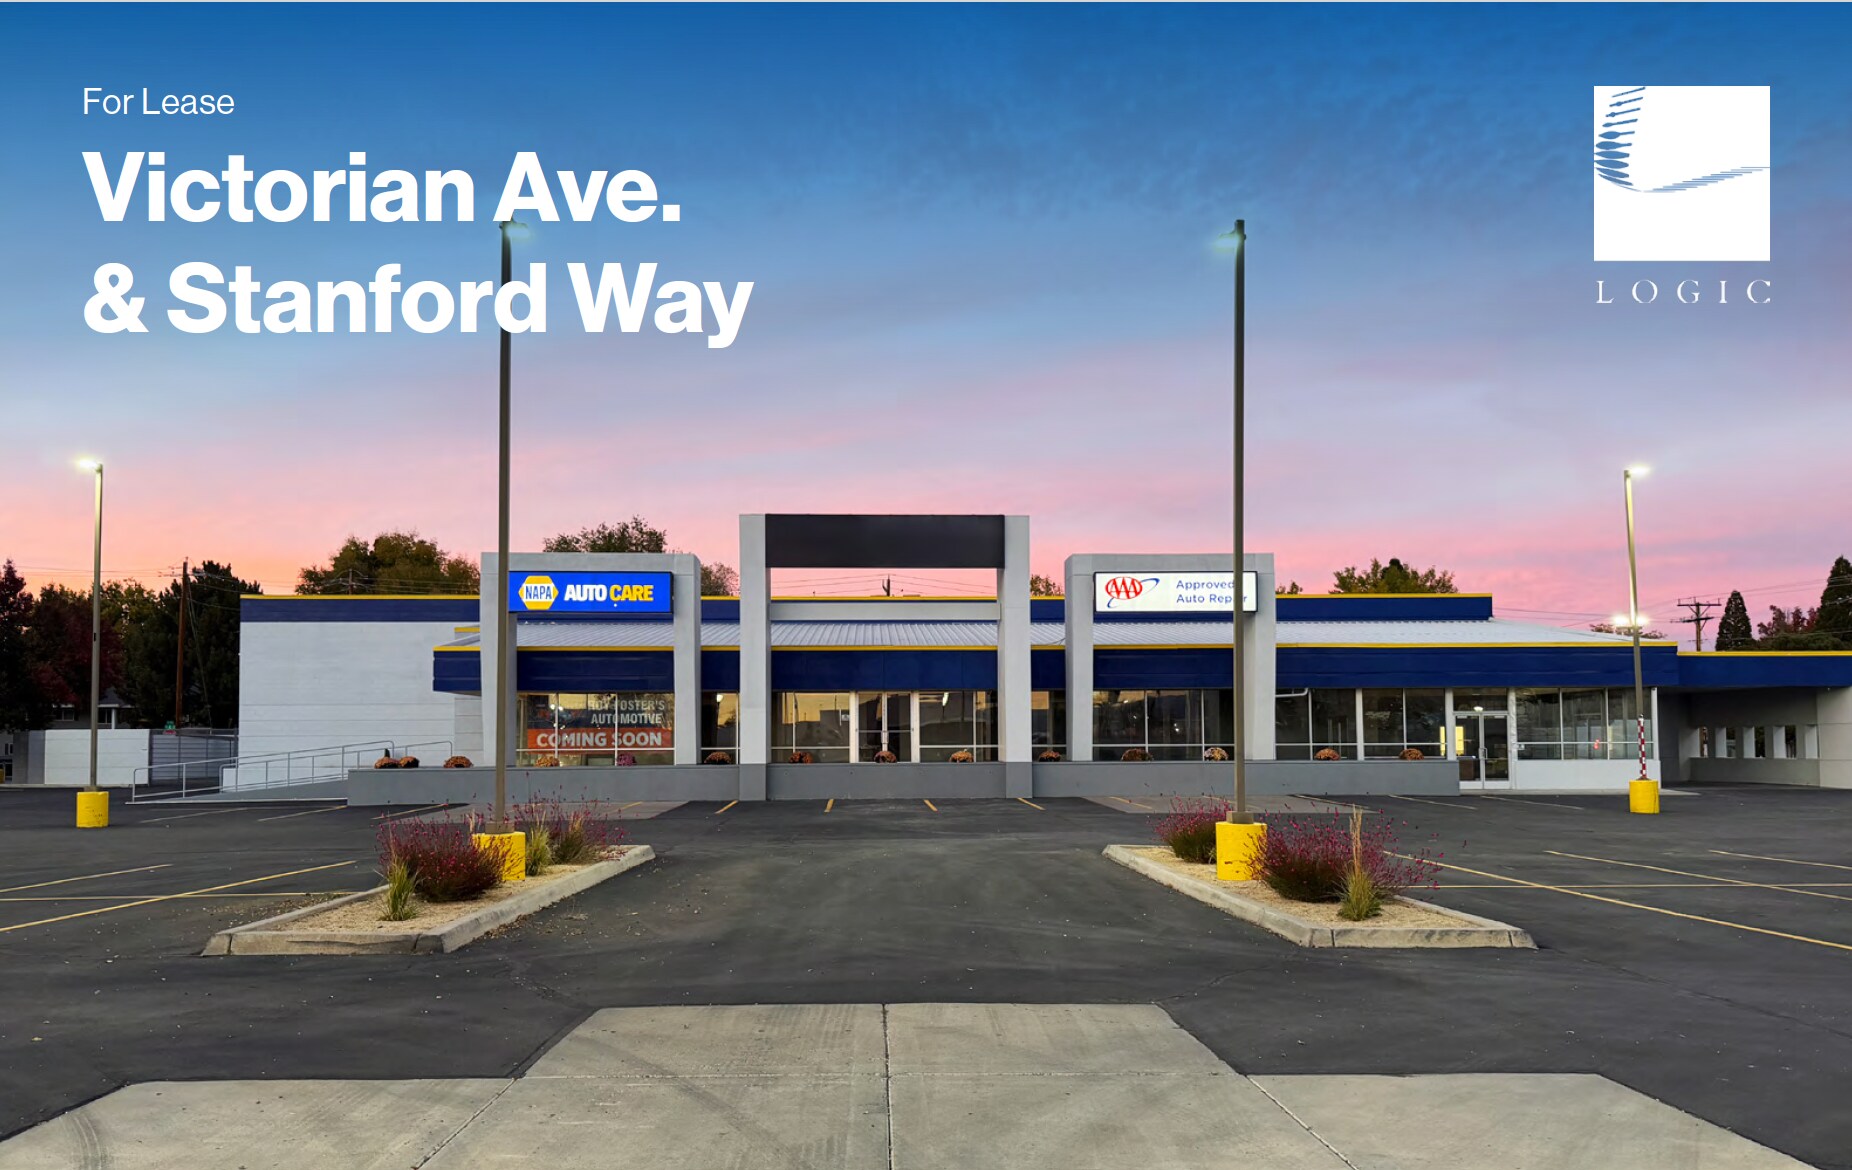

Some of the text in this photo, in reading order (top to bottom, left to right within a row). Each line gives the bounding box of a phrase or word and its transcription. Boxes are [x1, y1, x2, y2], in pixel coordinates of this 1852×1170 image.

[525, 585, 552, 600] NAPA
[1106, 577, 1142, 600] AAA
[1176, 580, 1235, 590] Approved
[564, 585, 654, 601] AUTO CARE
[1176, 594, 1247, 604] Auto Repr
[591, 713, 662, 724] AUTOMOTIVE
[536, 732, 662, 747] COMING SOON
